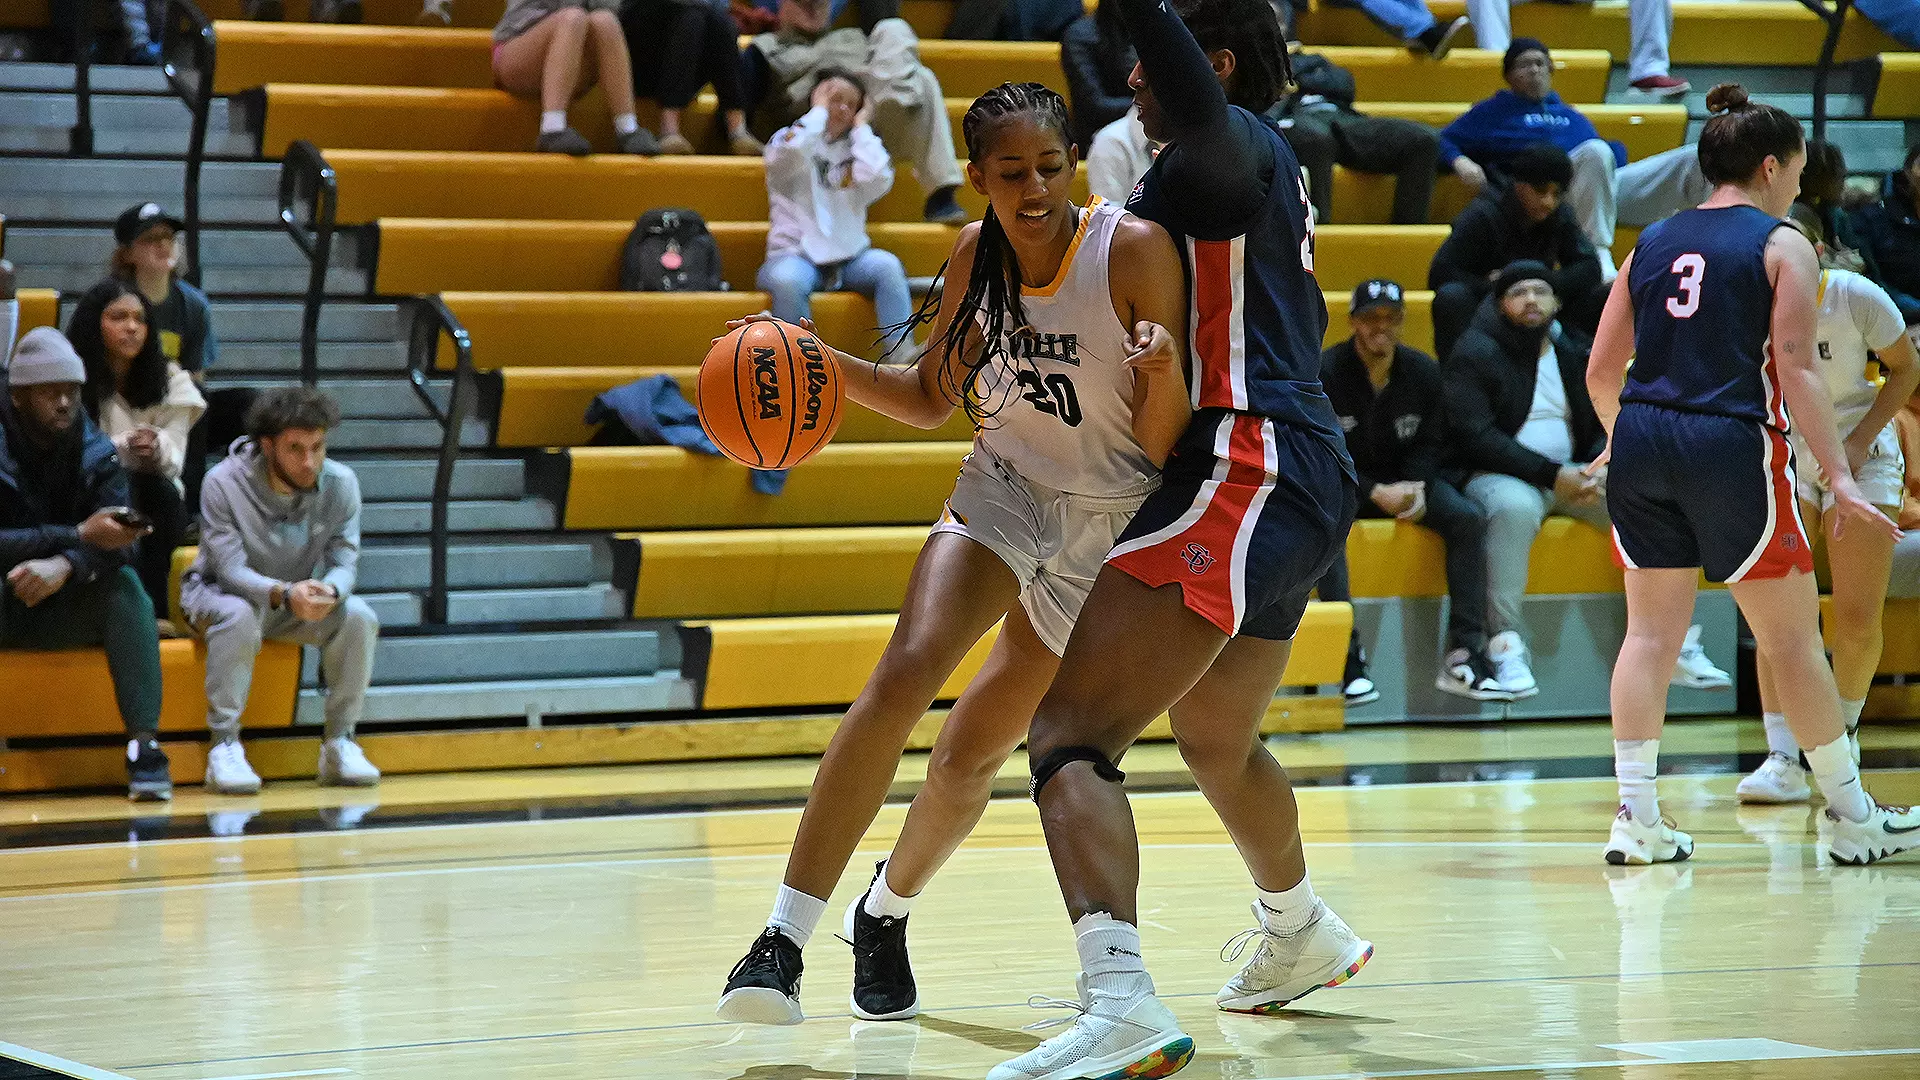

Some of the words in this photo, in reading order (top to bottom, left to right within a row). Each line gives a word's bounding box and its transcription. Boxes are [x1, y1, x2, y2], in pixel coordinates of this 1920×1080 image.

[1665, 252, 1706, 319] 3
[753, 347, 782, 420] NCAA
[796, 337, 828, 431] Wilson
[1017, 369, 1083, 428] 20
